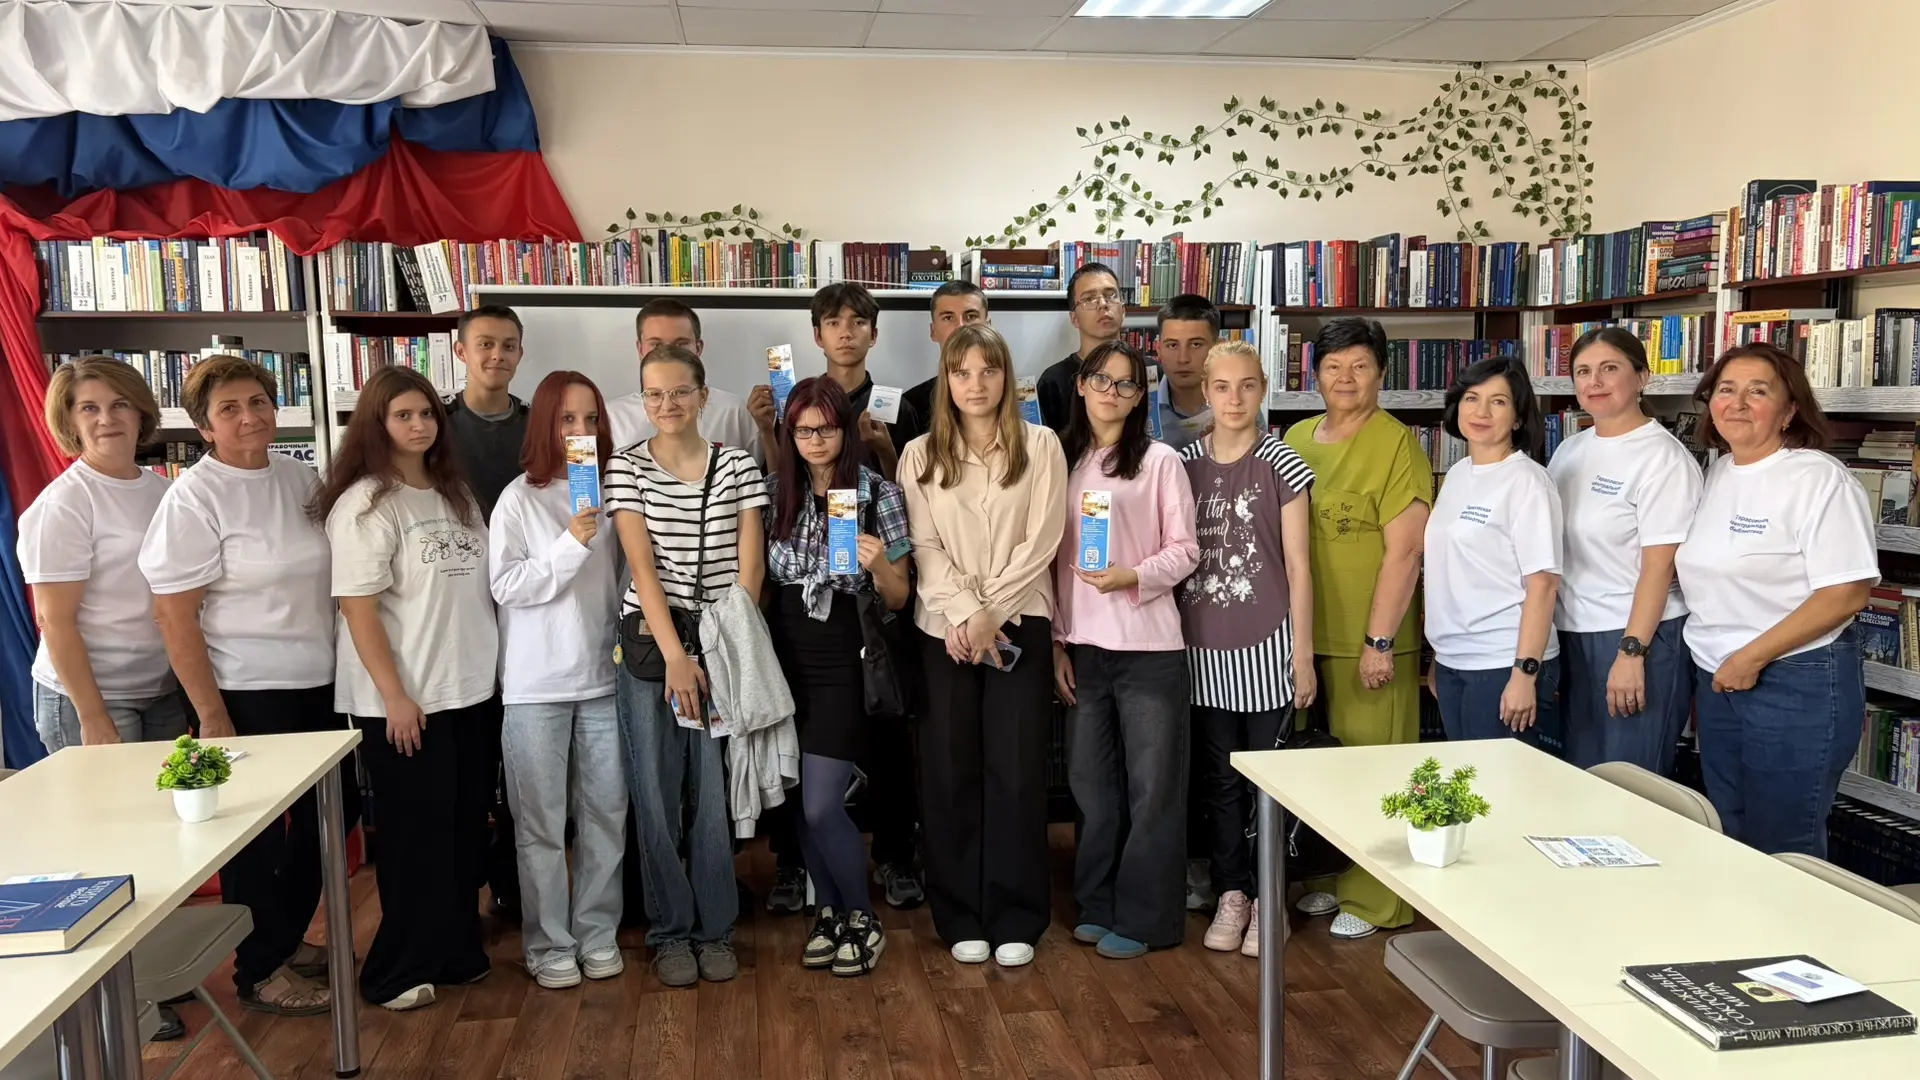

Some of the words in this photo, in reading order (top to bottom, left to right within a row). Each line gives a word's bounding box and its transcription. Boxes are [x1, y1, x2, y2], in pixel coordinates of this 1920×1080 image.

[1865, 192, 1874, 226] ЧАСТУШКИ
[1204, 491, 1226, 519] the
[1199, 543, 1228, 571] egin
[1859, 616, 1890, 627] ЗАЛЕССКИЙ
[1860, 611, 1896, 622] ПЕРЕСЛАВЛЬ-
[1647, 972, 1728, 1023] КНИЖНЫЕ
[1661, 966, 1754, 1027] СОКРОВИЩА
[1708, 981, 1750, 1008] МИРА
[1750, 1029, 1781, 1041] МИРА
[1786, 1023, 1853, 1038] СОКРОВИЩА
[1854, 1016, 1912, 1032] КНИЖНЫЕ
